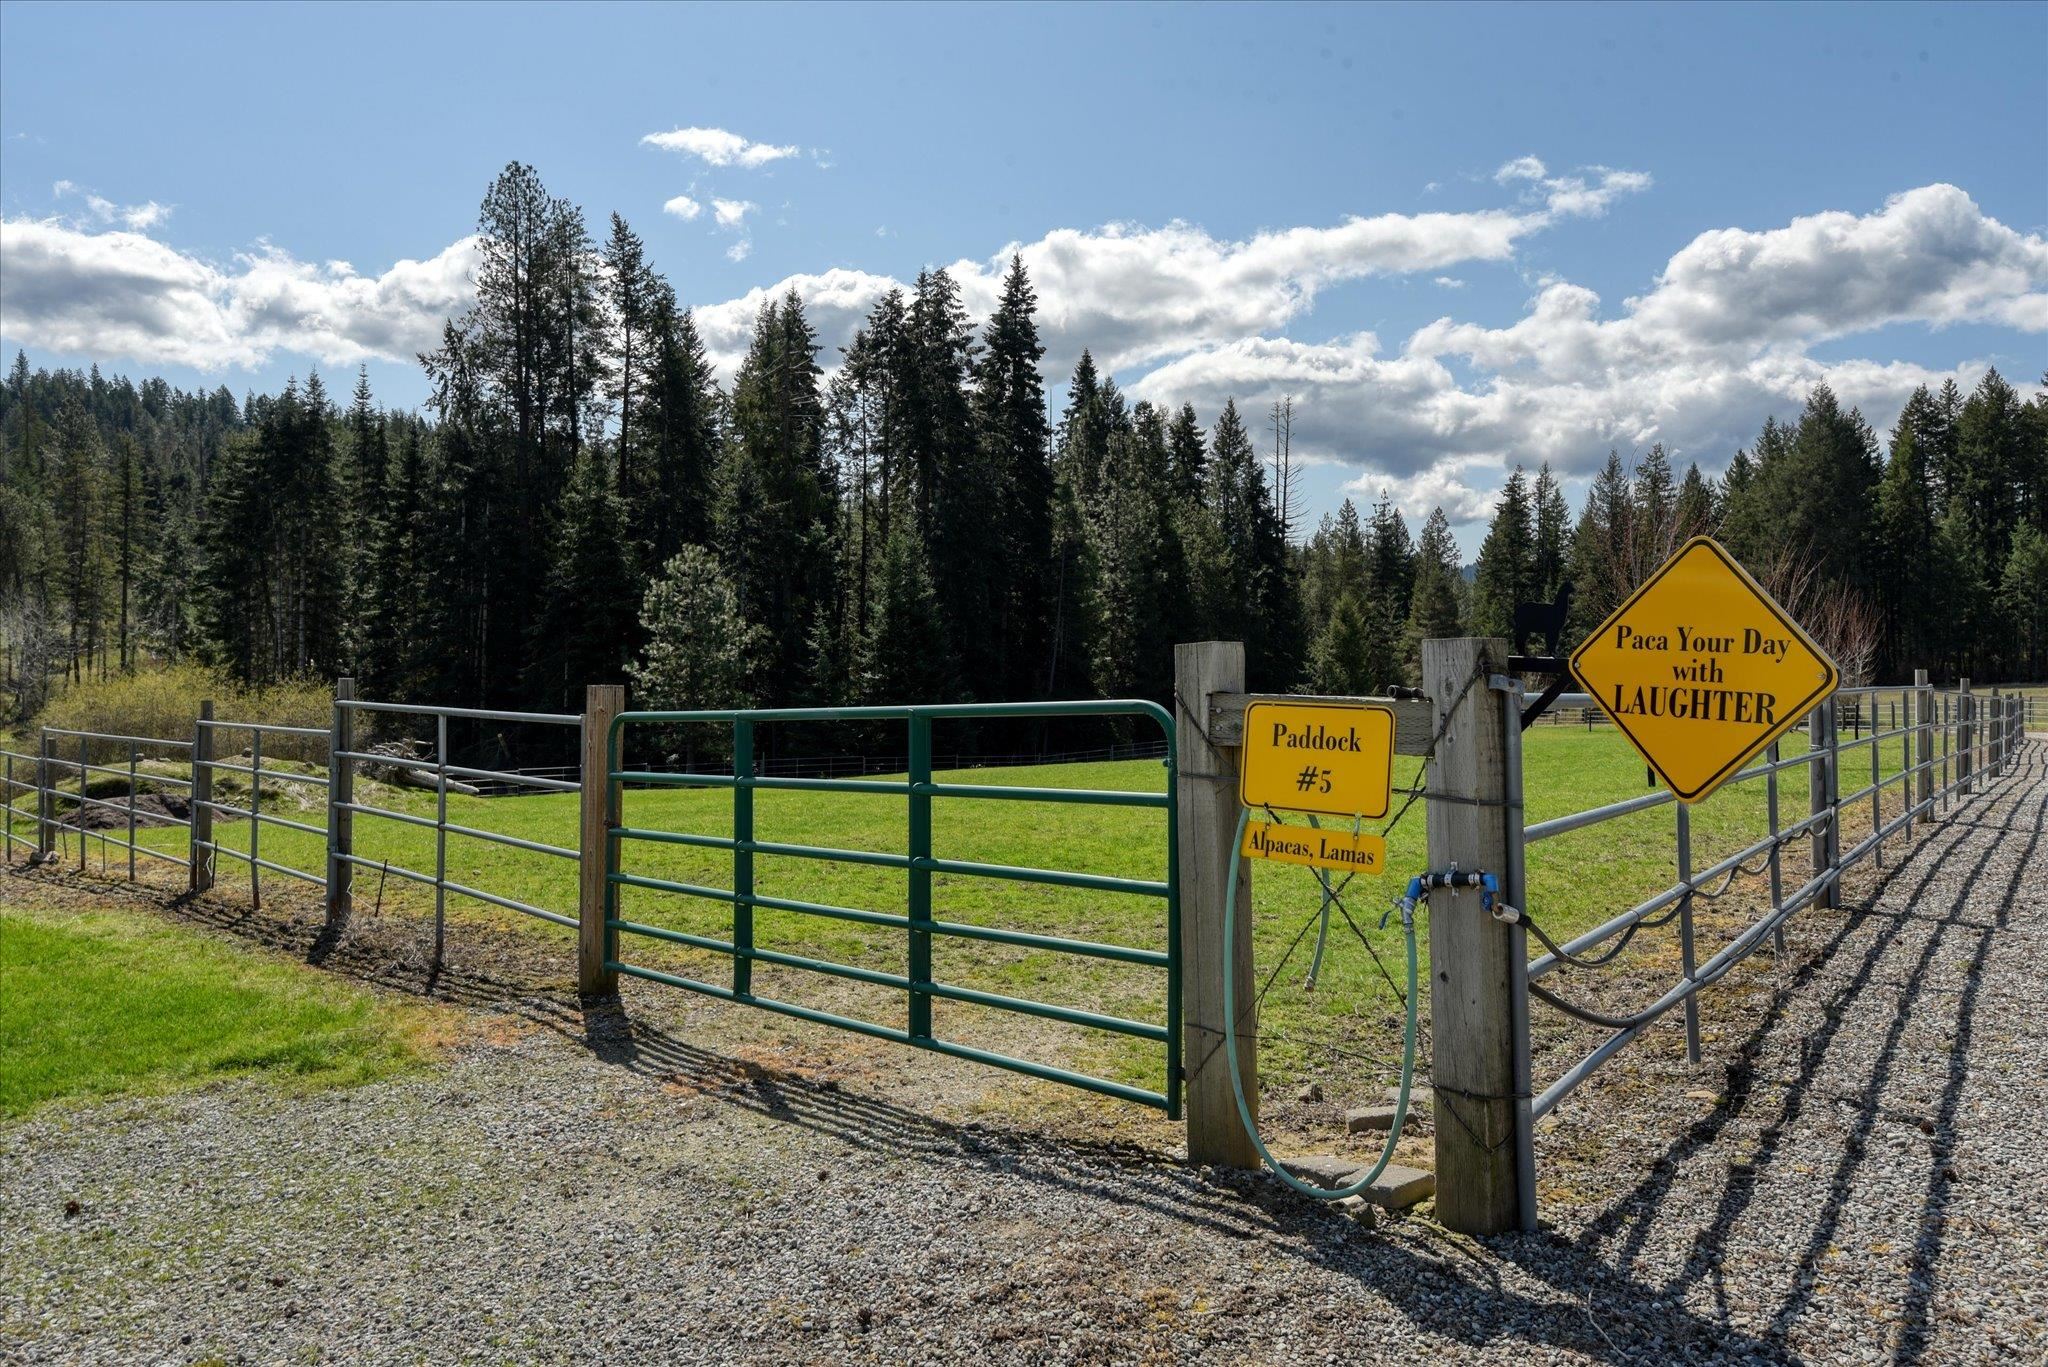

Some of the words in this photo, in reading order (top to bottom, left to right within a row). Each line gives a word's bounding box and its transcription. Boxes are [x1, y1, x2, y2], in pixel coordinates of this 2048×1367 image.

[1615, 625, 1668, 651] Paca
[1676, 626, 1735, 653] Your
[1742, 628, 1791, 663] Day
[1672, 658, 1724, 683] with
[1613, 684, 1777, 726] LAUGHTER
[1272, 723, 1361, 752] Paddock
[1296, 765, 1332, 794] #5
[1249, 830, 1314, 862] Alpacas,
[1319, 838, 1374, 865] Lamas
